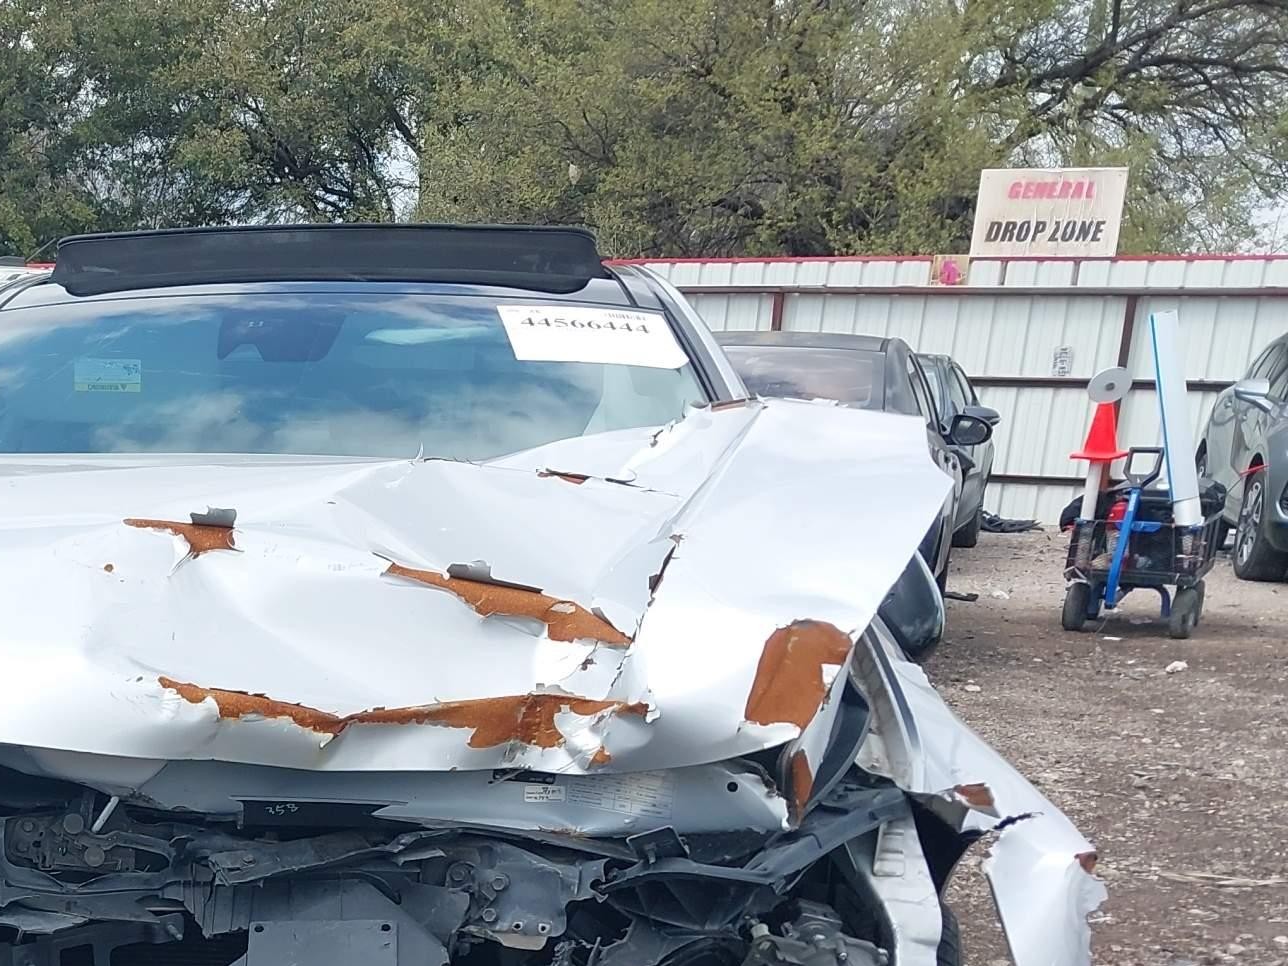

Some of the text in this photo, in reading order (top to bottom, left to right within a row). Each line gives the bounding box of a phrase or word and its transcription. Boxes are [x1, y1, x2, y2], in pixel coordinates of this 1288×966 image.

[1008, 181, 1096, 199] GENERAL
[984, 220, 1107, 243] DROP ZONE
[520, 315, 650, 334] 44566444
